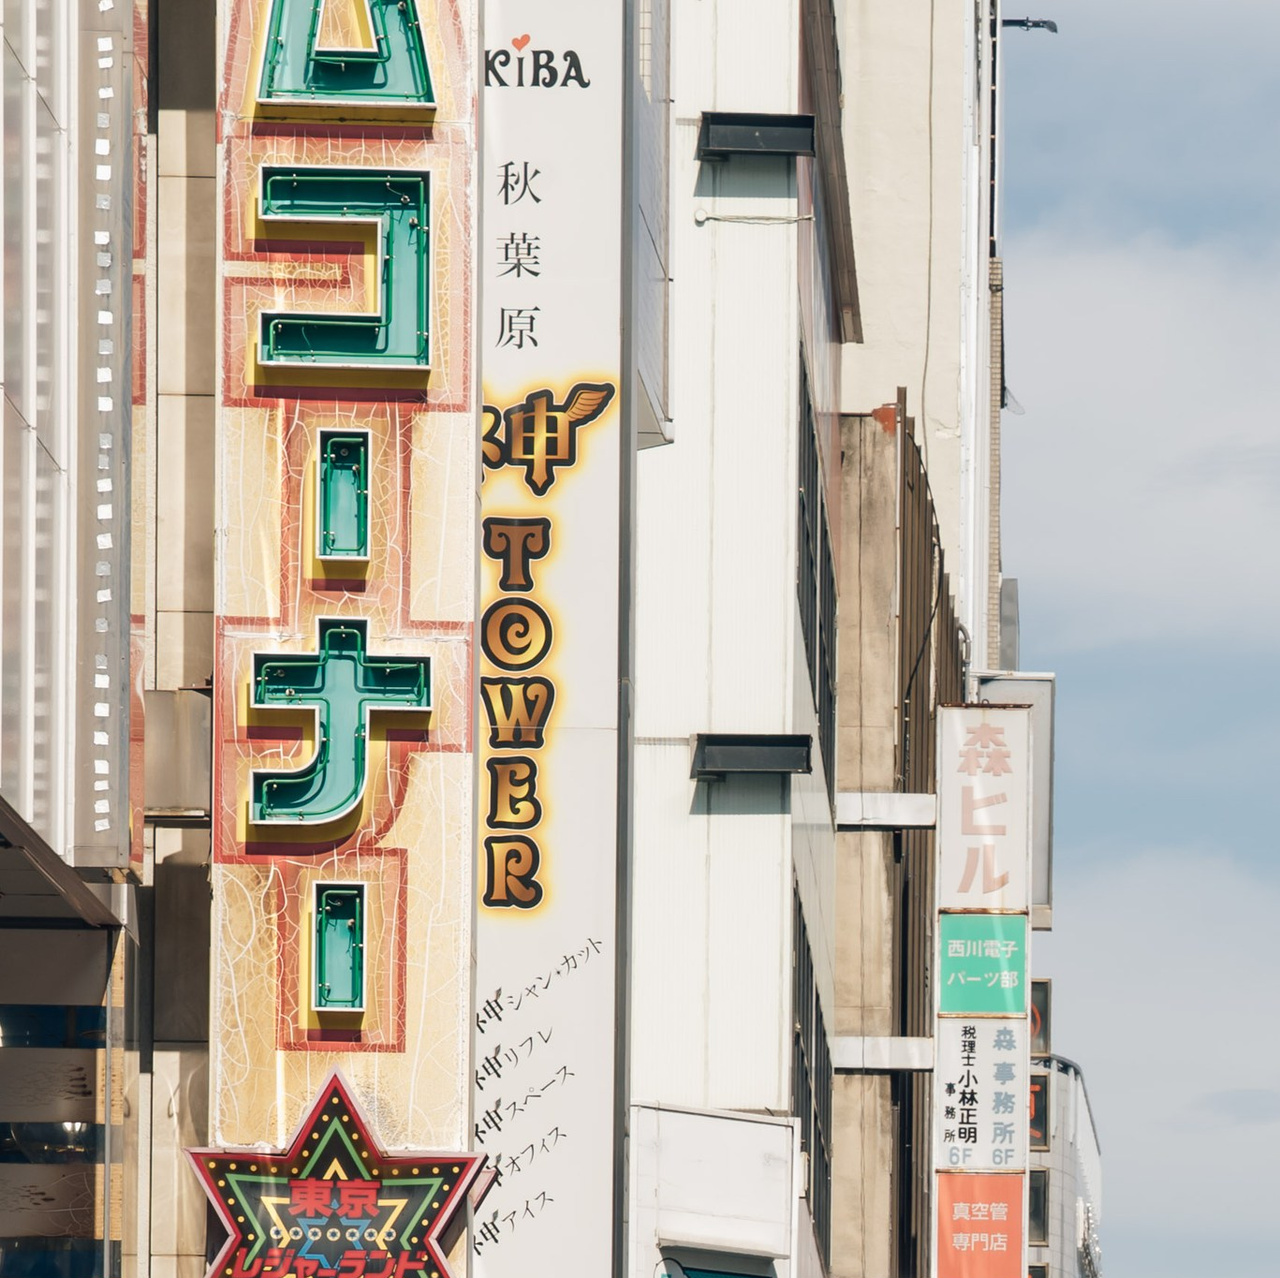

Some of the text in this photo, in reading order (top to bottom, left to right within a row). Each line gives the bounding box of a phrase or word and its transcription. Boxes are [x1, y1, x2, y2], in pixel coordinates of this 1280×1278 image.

[495, 160, 542, 350] 秋葉原
[956, 723, 1012, 896] 森ビル
[947, 939, 1018, 958] 西川電子
[947, 970, 1018, 989] パーツ部
[957, 1026, 979, 1144] 税理士小林正明
[991, 1026, 1017, 1145] 森事務所
[943, 1082, 956, 1143] 事務所
[949, 1146, 973, 1166] 6F
[992, 1148, 1015, 1166] 6F
[288, 1177, 381, 1218] 東京
[952, 1202, 1008, 1221] 真空管
[952, 1233, 1008, 1251] 専門店
